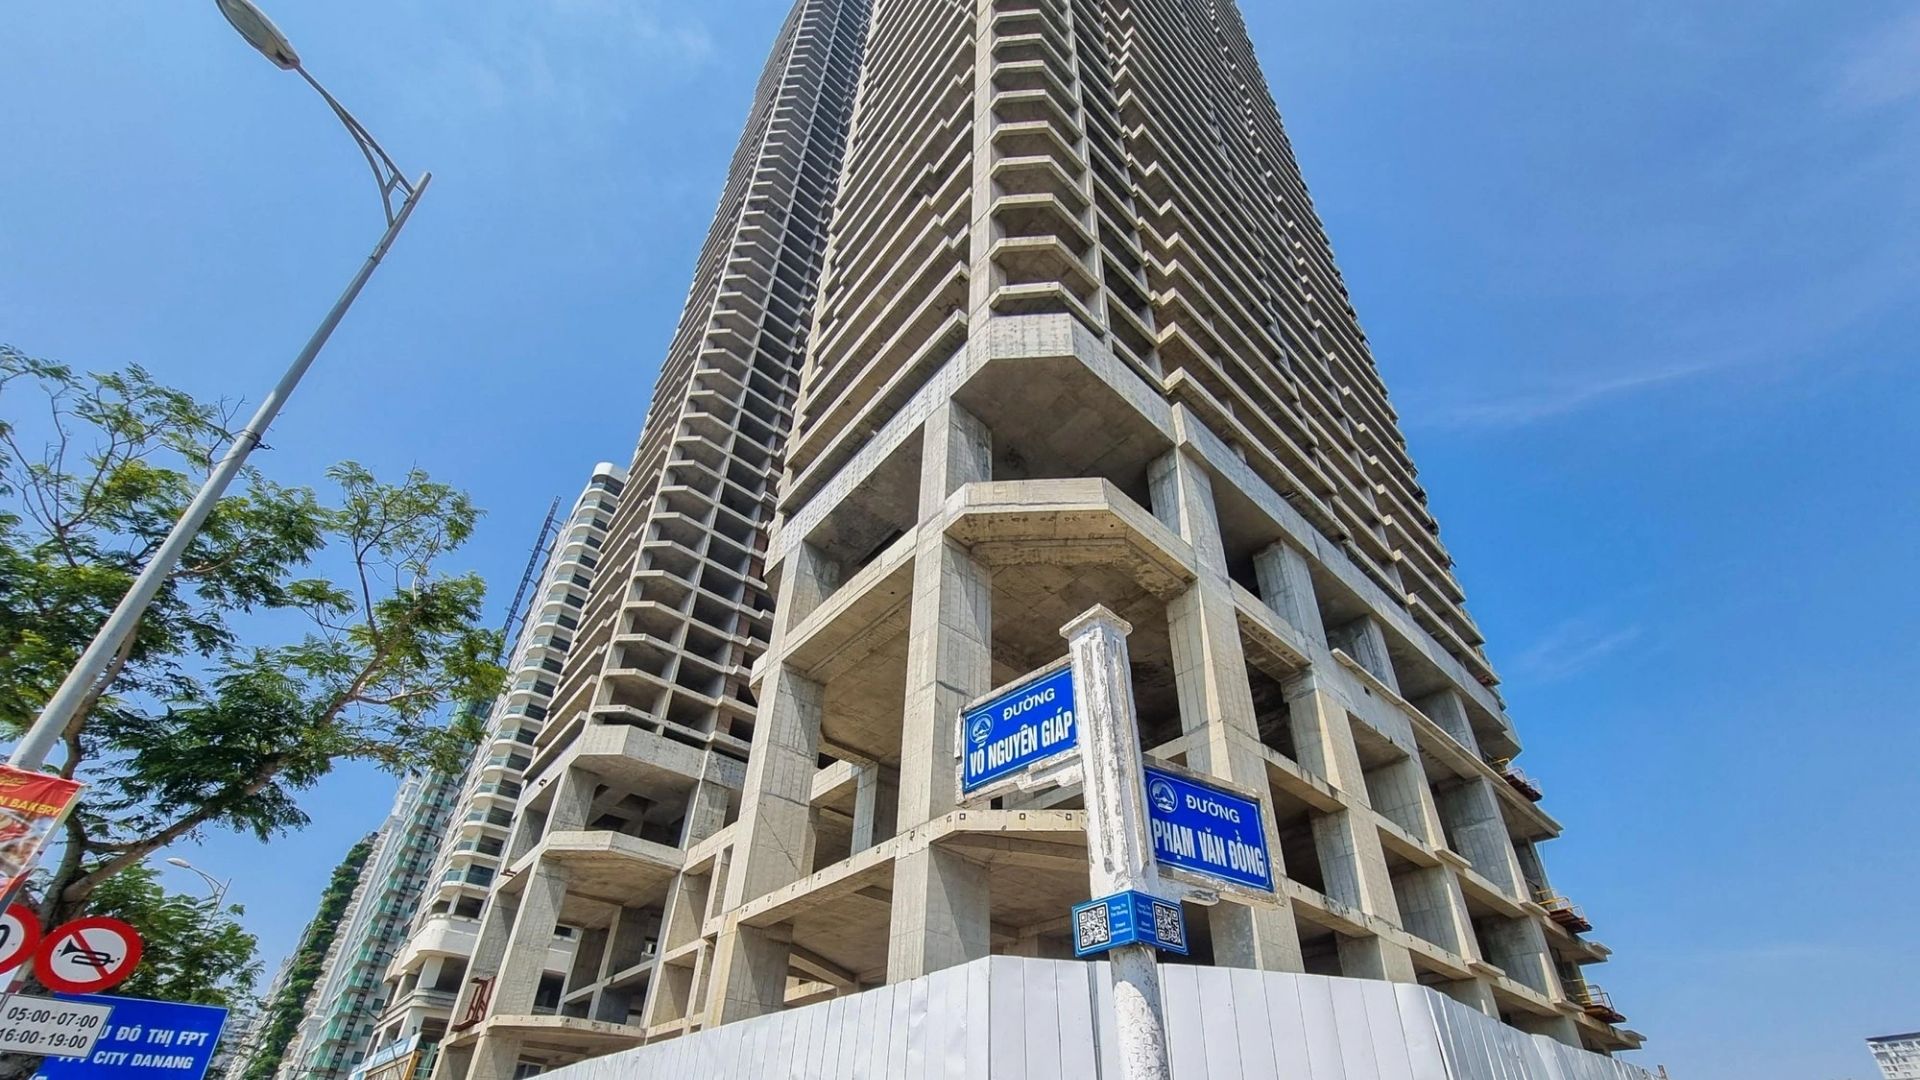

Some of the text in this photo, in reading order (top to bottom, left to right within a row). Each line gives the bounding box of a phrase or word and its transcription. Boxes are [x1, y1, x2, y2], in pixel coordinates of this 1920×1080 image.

[1003, 688, 1055, 720] ĐƯỜNG
[970, 706, 1073, 777] VÕ NGUYÊN GIÁP
[9, 798, 62, 816] BAKERY
[1186, 794, 1240, 823] ĐƯỜNG
[1152, 818, 1266, 878] PHẠM VĂN ĐỒNG
[115, 1024, 142, 1042] ĐÔ
[147, 1028, 175, 1047] THỊ
[176, 1030, 209, 1047] FPT
[93, 1050, 129, 1066] CITY
[130, 1053, 194, 1070] DANANG
